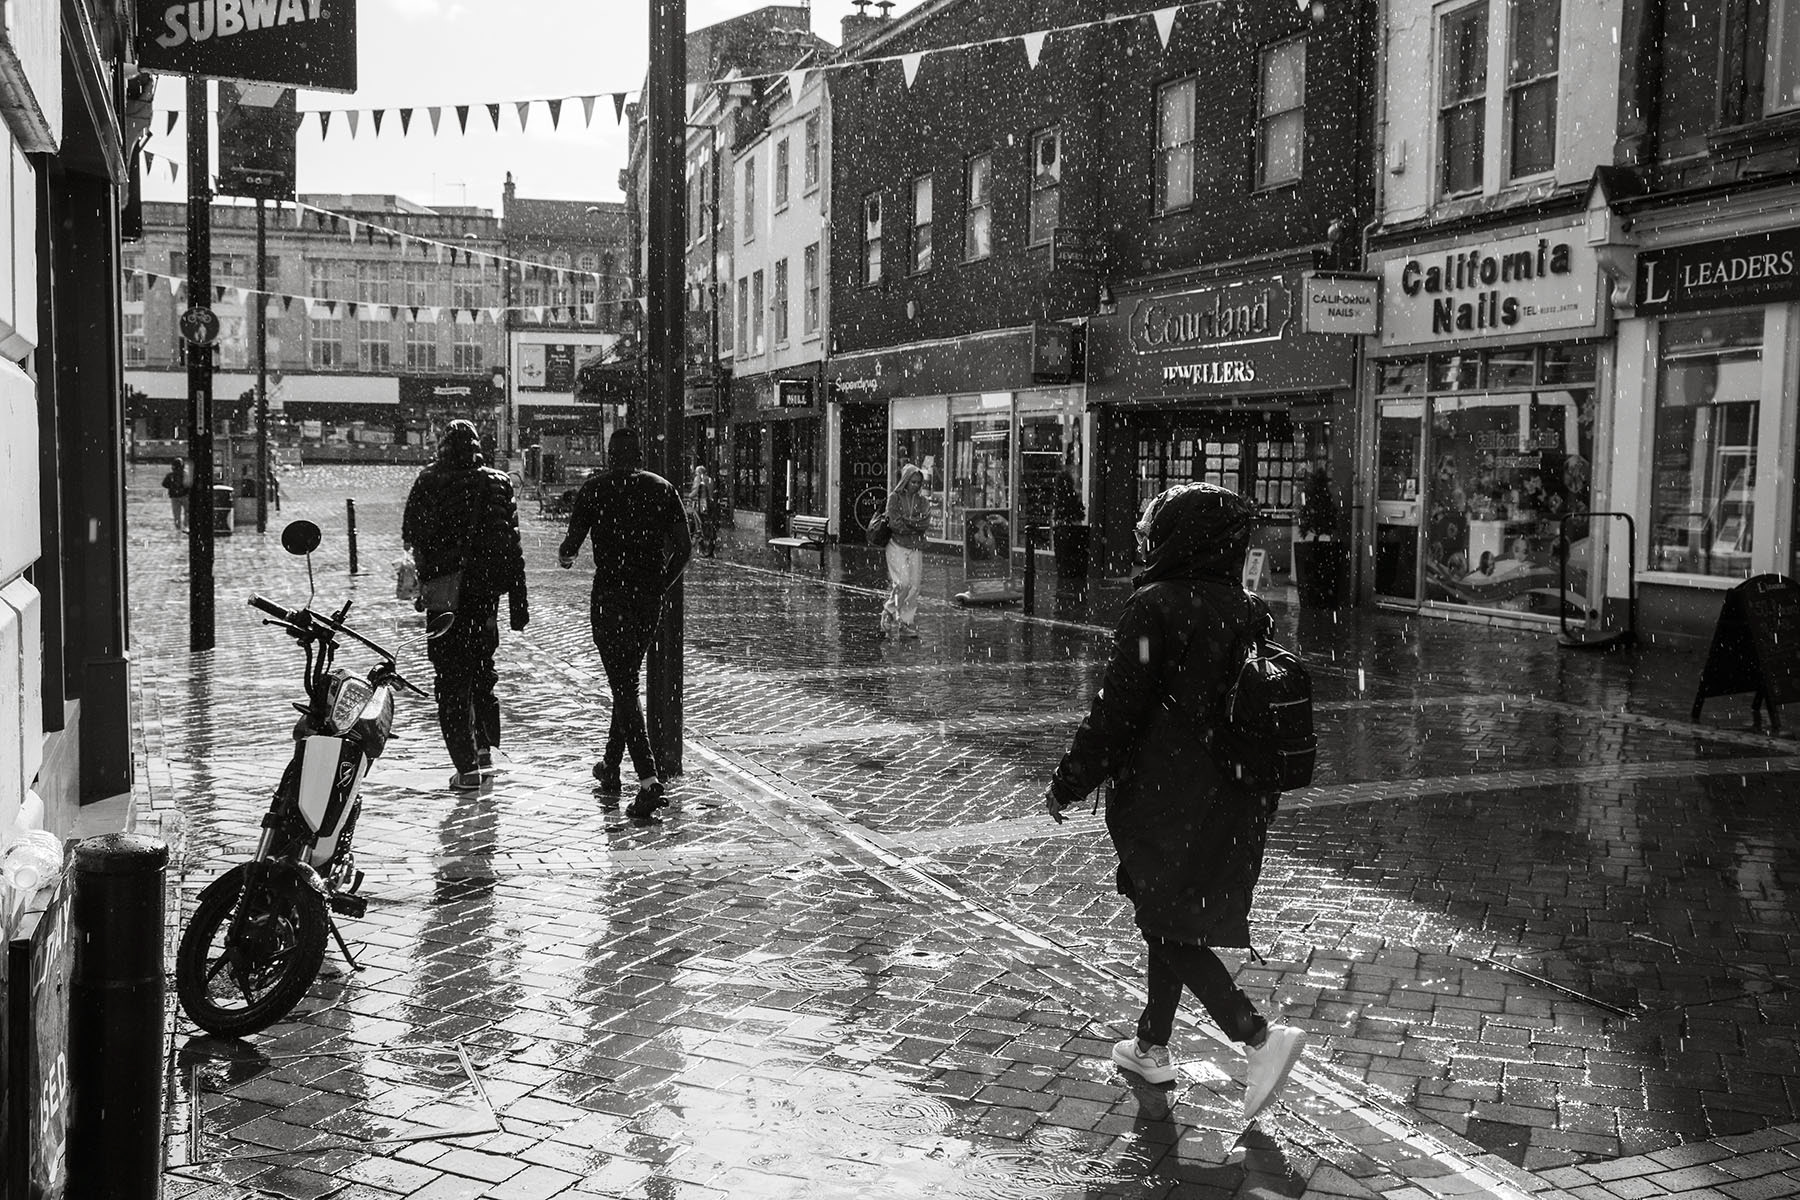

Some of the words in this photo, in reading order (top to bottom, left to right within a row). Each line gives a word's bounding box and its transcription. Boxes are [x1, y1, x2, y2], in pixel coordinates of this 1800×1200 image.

[1402, 238, 1573, 297] California
[1643, 260, 1670, 304] L
[1684, 251, 1793, 287] LEADERS
[1312, 294, 1371, 305] CALIFORNIA
[1328, 308, 1354, 318] NAILS
[1432, 290, 1521, 334] Nails
[835, 376, 878, 394] Superdrug
[1162, 359, 1256, 387] JEWELLERS
